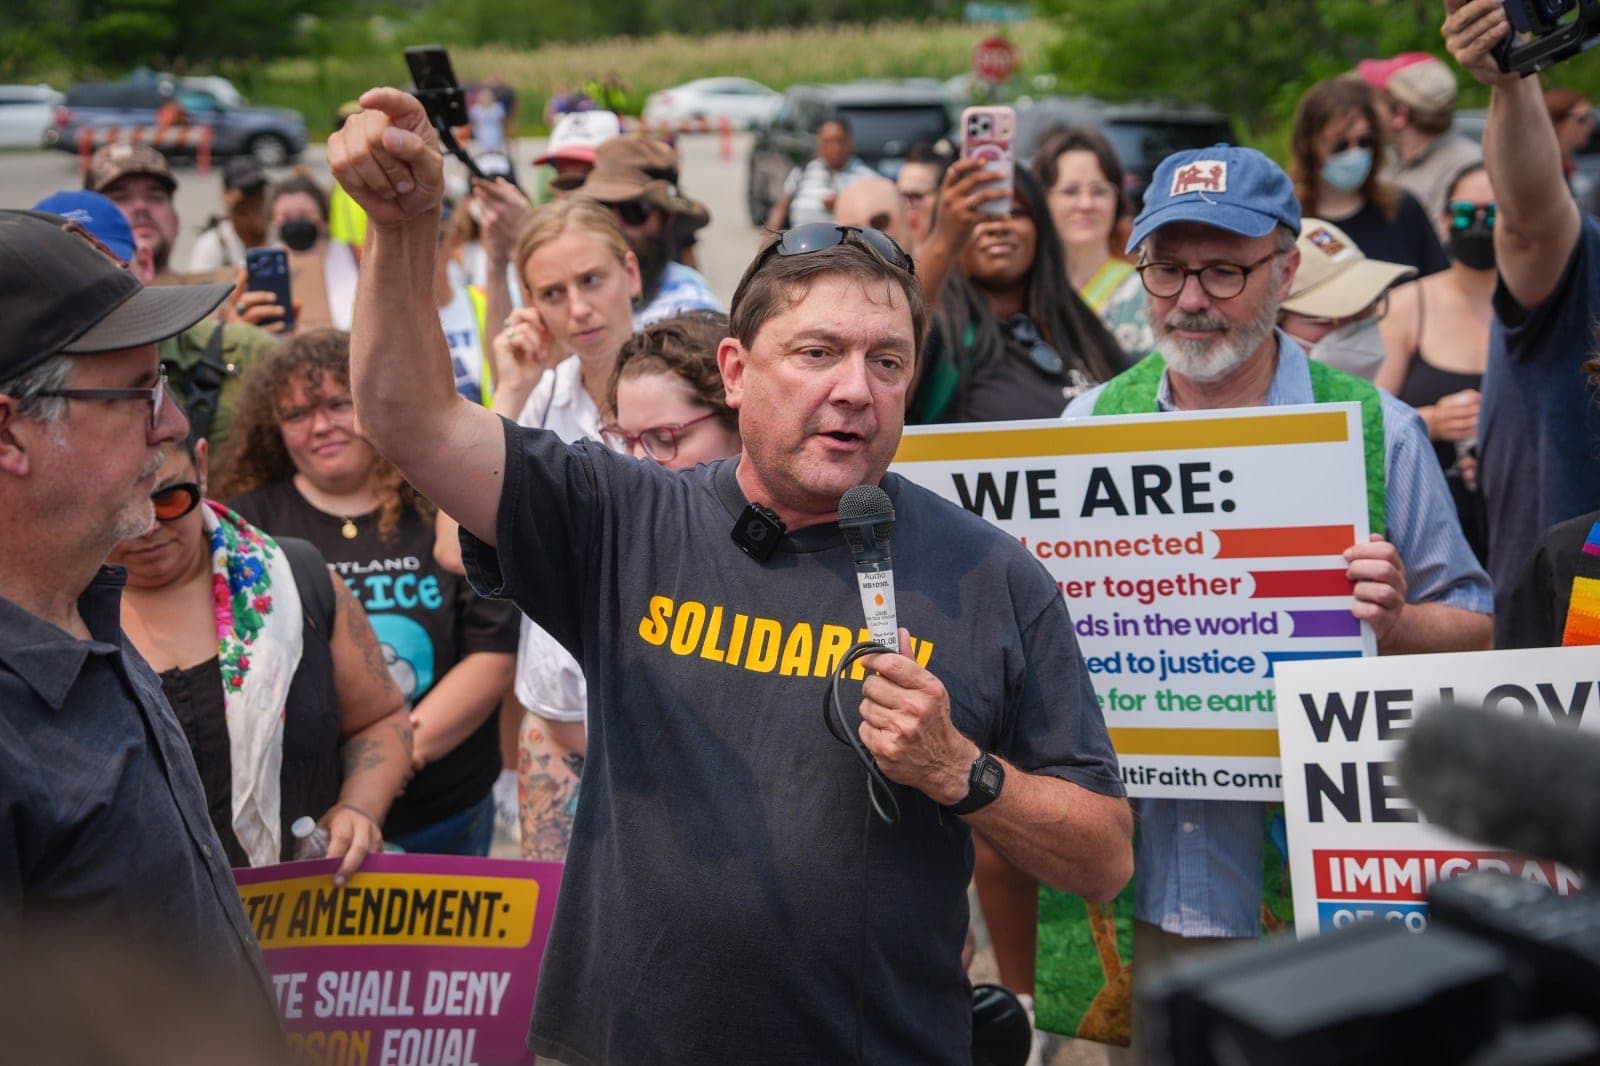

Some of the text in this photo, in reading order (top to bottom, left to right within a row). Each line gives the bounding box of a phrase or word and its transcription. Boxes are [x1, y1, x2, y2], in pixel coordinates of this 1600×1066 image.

[952, 461, 1236, 519] WE ARE:
[1036, 531, 1204, 559] connected
[1103, 573, 1242, 605] together
[638, 594, 934, 681] SOLIDARIY
[1112, 611, 1141, 637] in
[1143, 612, 1192, 636] the
[1195, 611, 1279, 636] world
[1083, 648, 1256, 682] ed to justice
[1108, 687, 1147, 712] for
[1155, 688, 1202, 712] the
[1299, 680, 1600, 742] WE OV
[1122, 765, 1208, 787] ltiFaith
[241, 887, 510, 941] TH AMENDMENT:
[314, 970, 415, 1018] SHALL
[422, 970, 512, 1017] DENY
[380, 1027, 480, 1066] EQUAL
